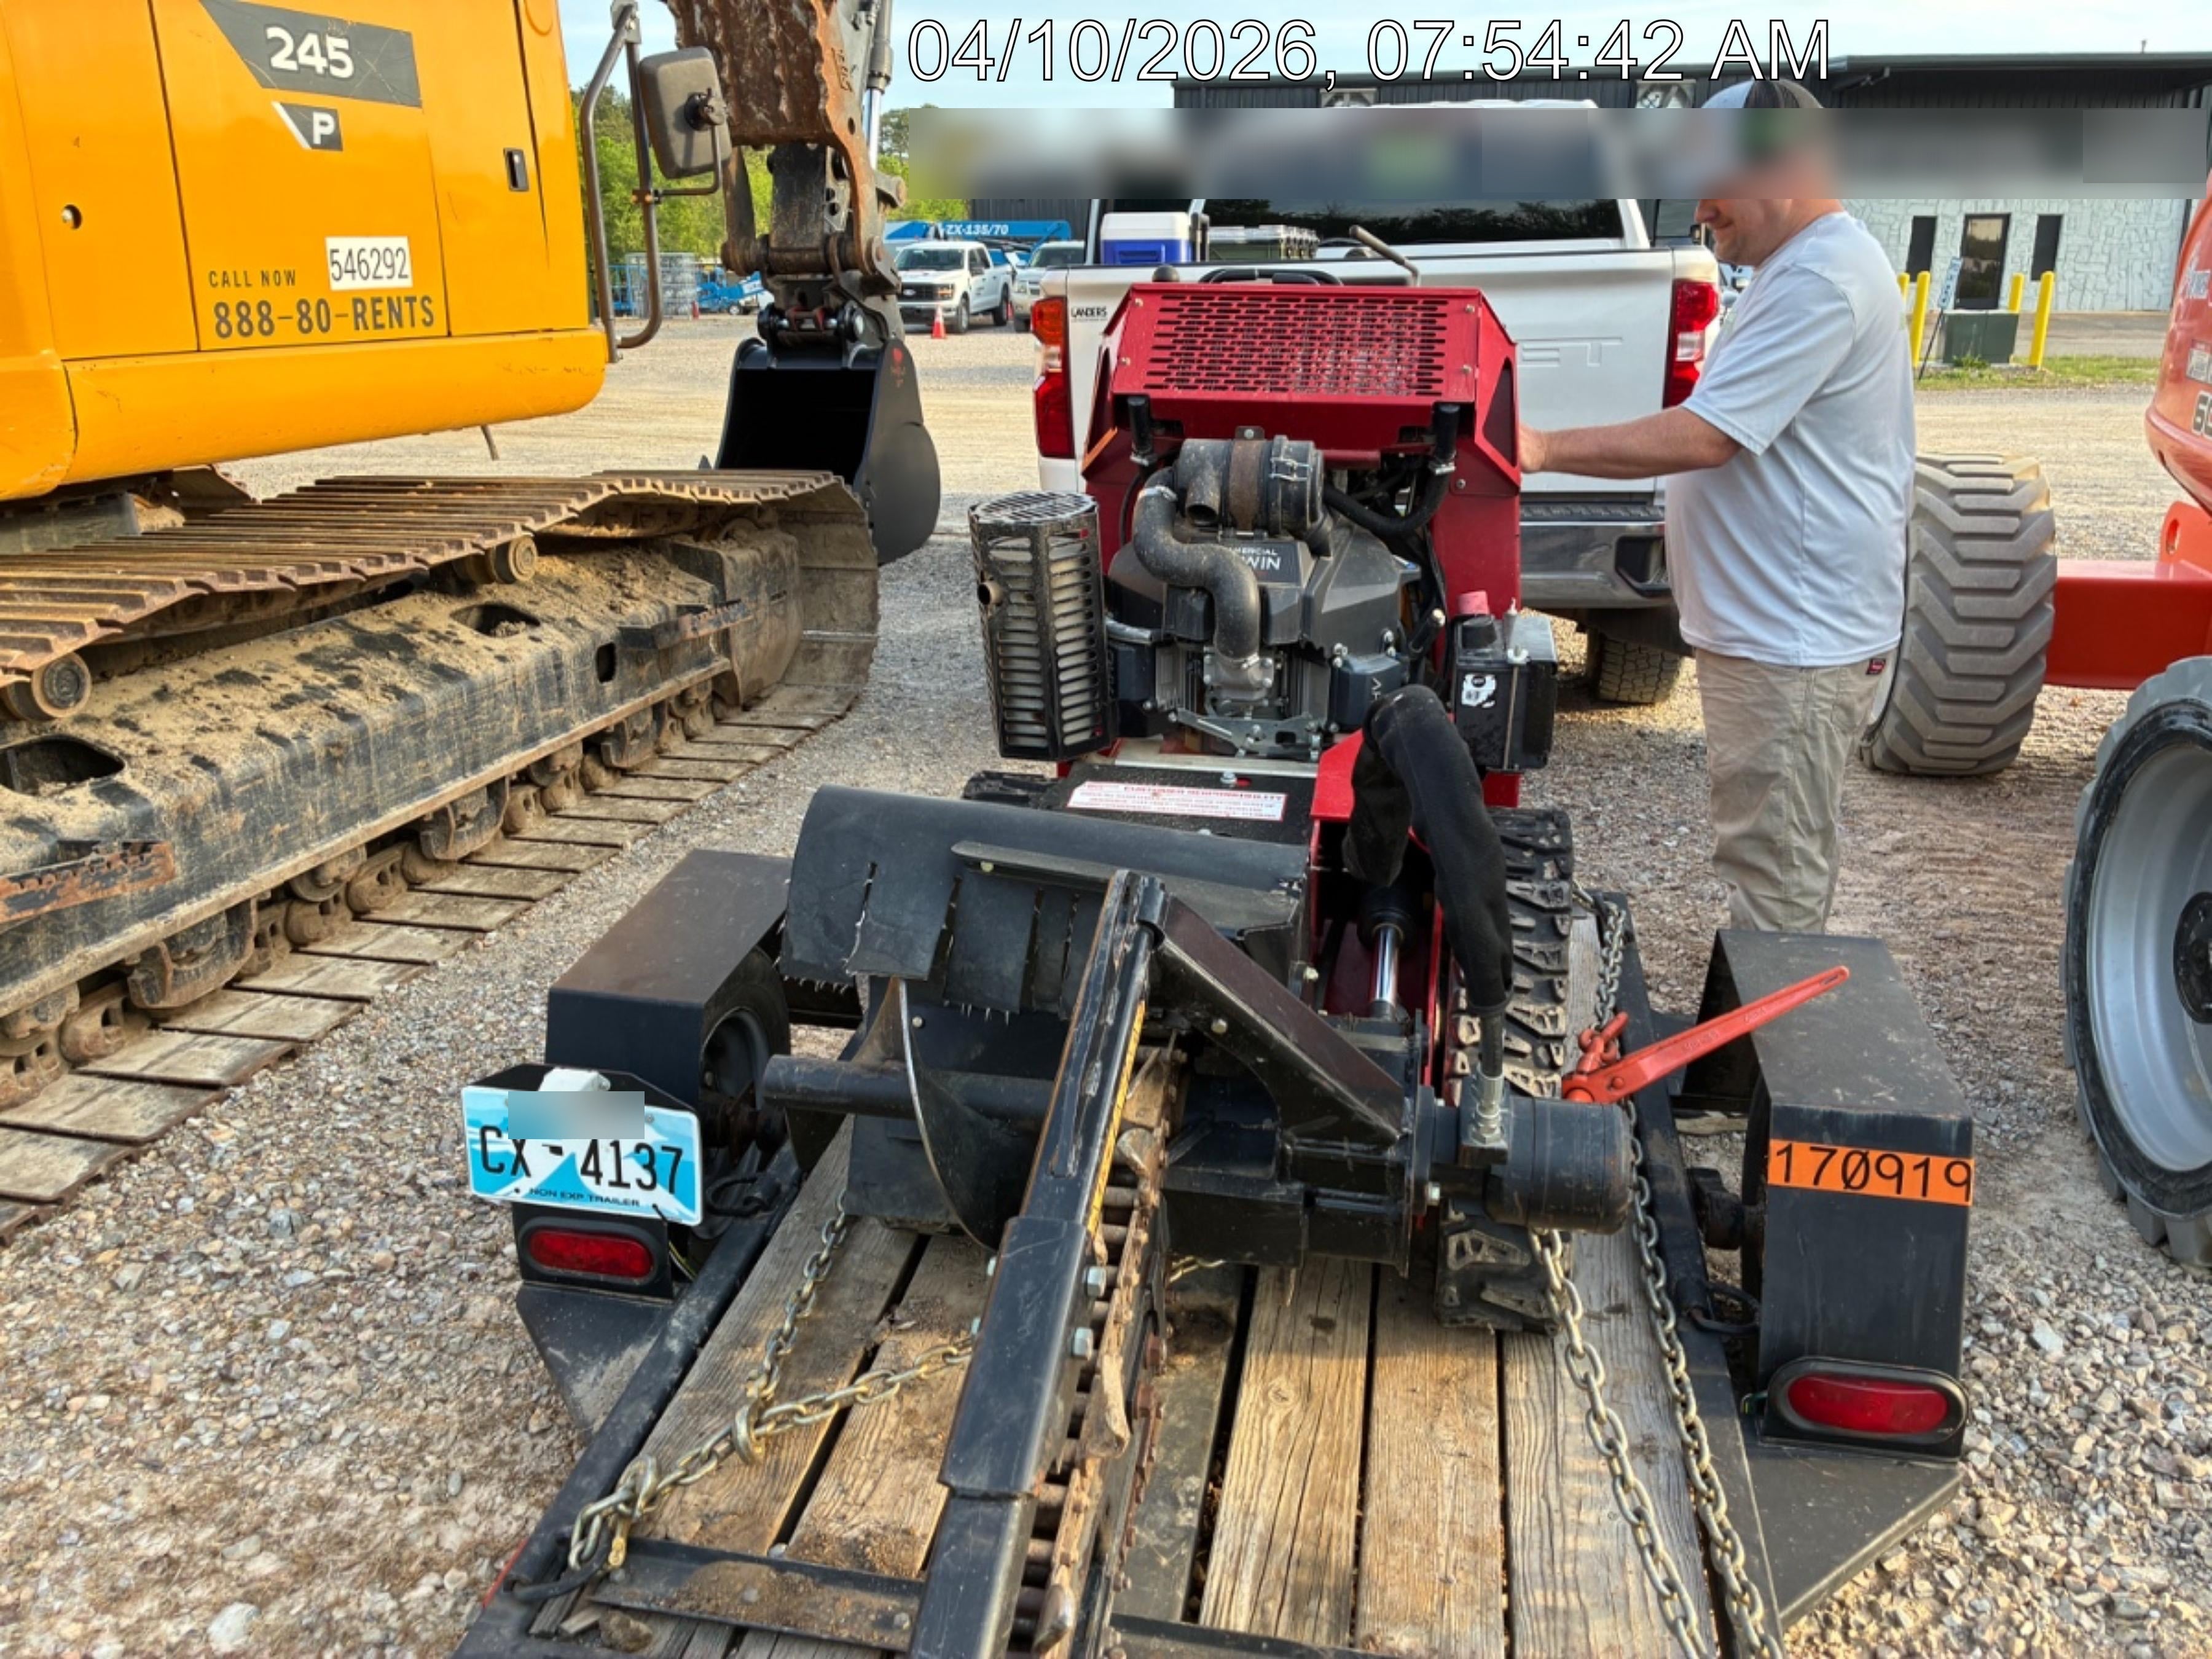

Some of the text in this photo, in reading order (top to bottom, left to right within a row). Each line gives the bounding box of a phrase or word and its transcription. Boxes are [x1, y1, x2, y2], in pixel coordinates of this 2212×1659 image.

[266, 26, 355, 79] 245
[312, 111, 336, 145] P
[945, 224, 1009, 235] ZX-135/70
[208, 269, 296, 288] CALL NOW
[329, 247, 409, 281] 546292
[213, 295, 435, 339] 888-80-RENTS
[479, 1125, 684, 1194] CX 4137
[529, 1187, 640, 1207] NON EXP TRAILER
